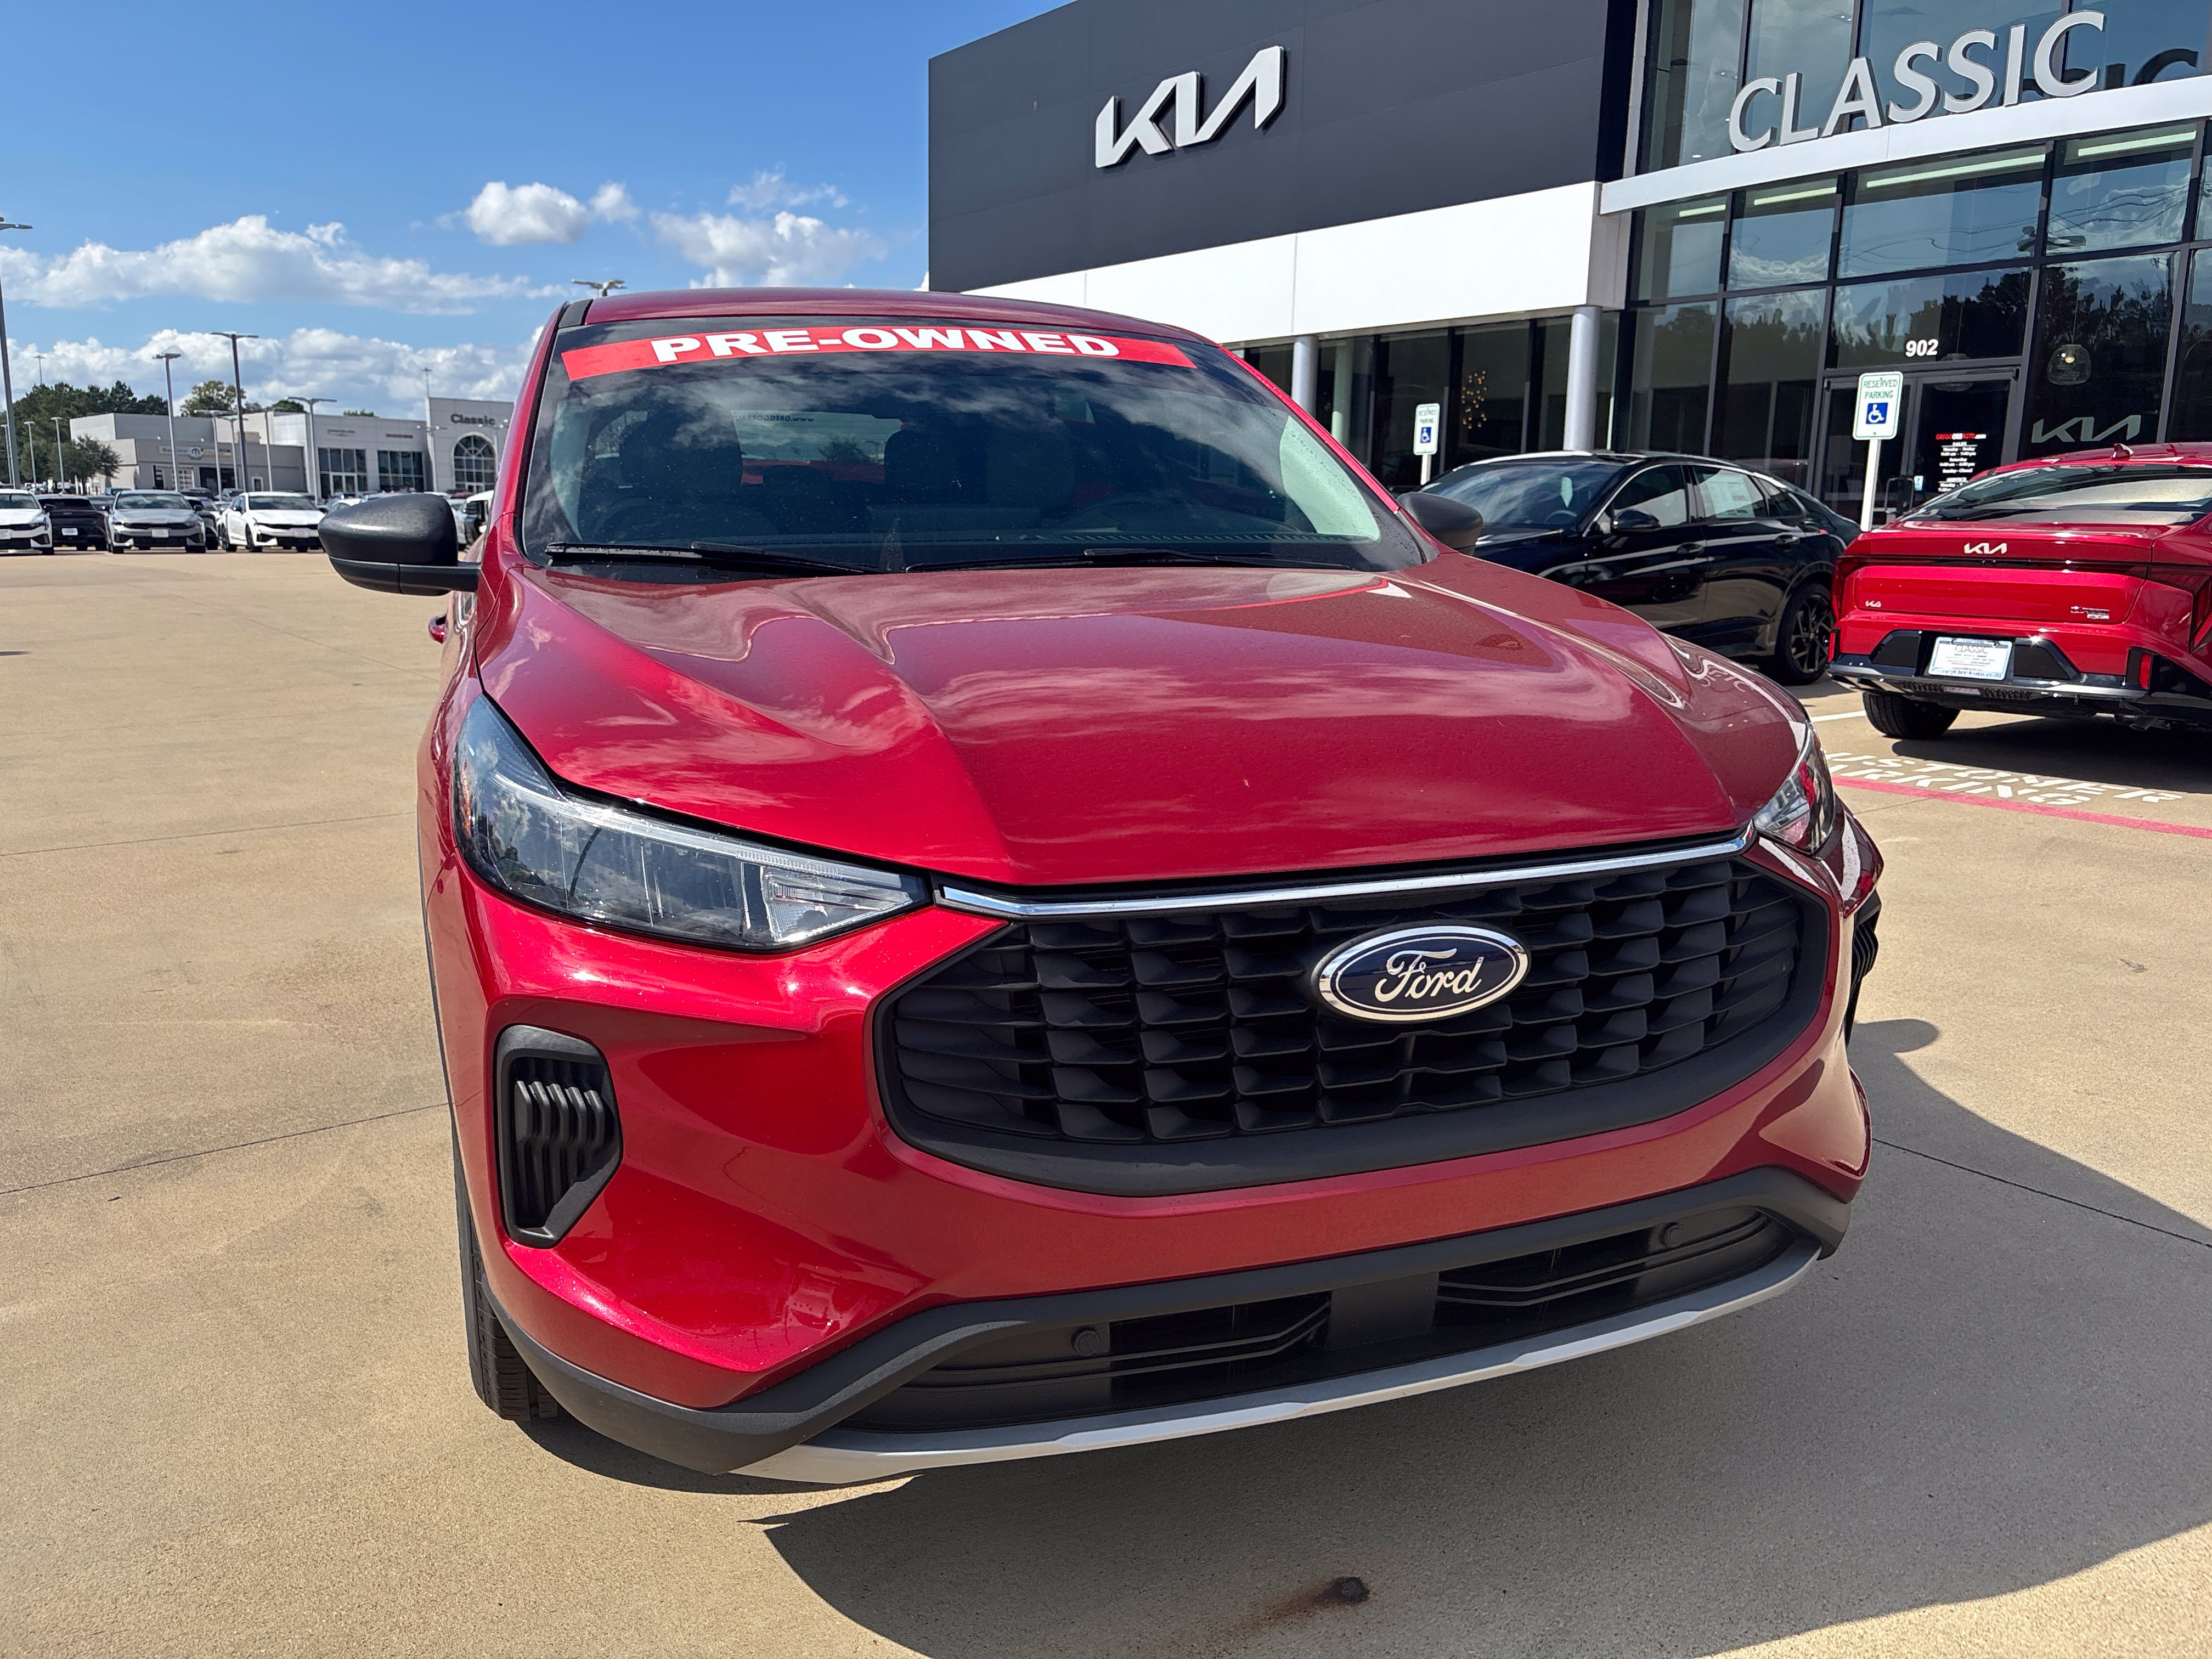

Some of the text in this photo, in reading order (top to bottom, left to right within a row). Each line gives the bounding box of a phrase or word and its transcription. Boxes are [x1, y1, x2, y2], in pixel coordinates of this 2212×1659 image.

[1729, 10, 2106, 153] CLASSIC
[1096, 45, 1285, 168] KIA
[651, 328, 1120, 363] PRE-OWNED
[1905, 338, 1938, 357] 902
[1863, 379, 1898, 388] RESERVED
[1865, 390, 1894, 399] PARKING
[450, 414, 495, 426] Classic
[2032, 415, 2141, 443] KIA
[1963, 543, 2007, 554] KIA
[1822, 751, 2182, 803] USTOMER
[1374, 947, 1485, 1002] Ford
